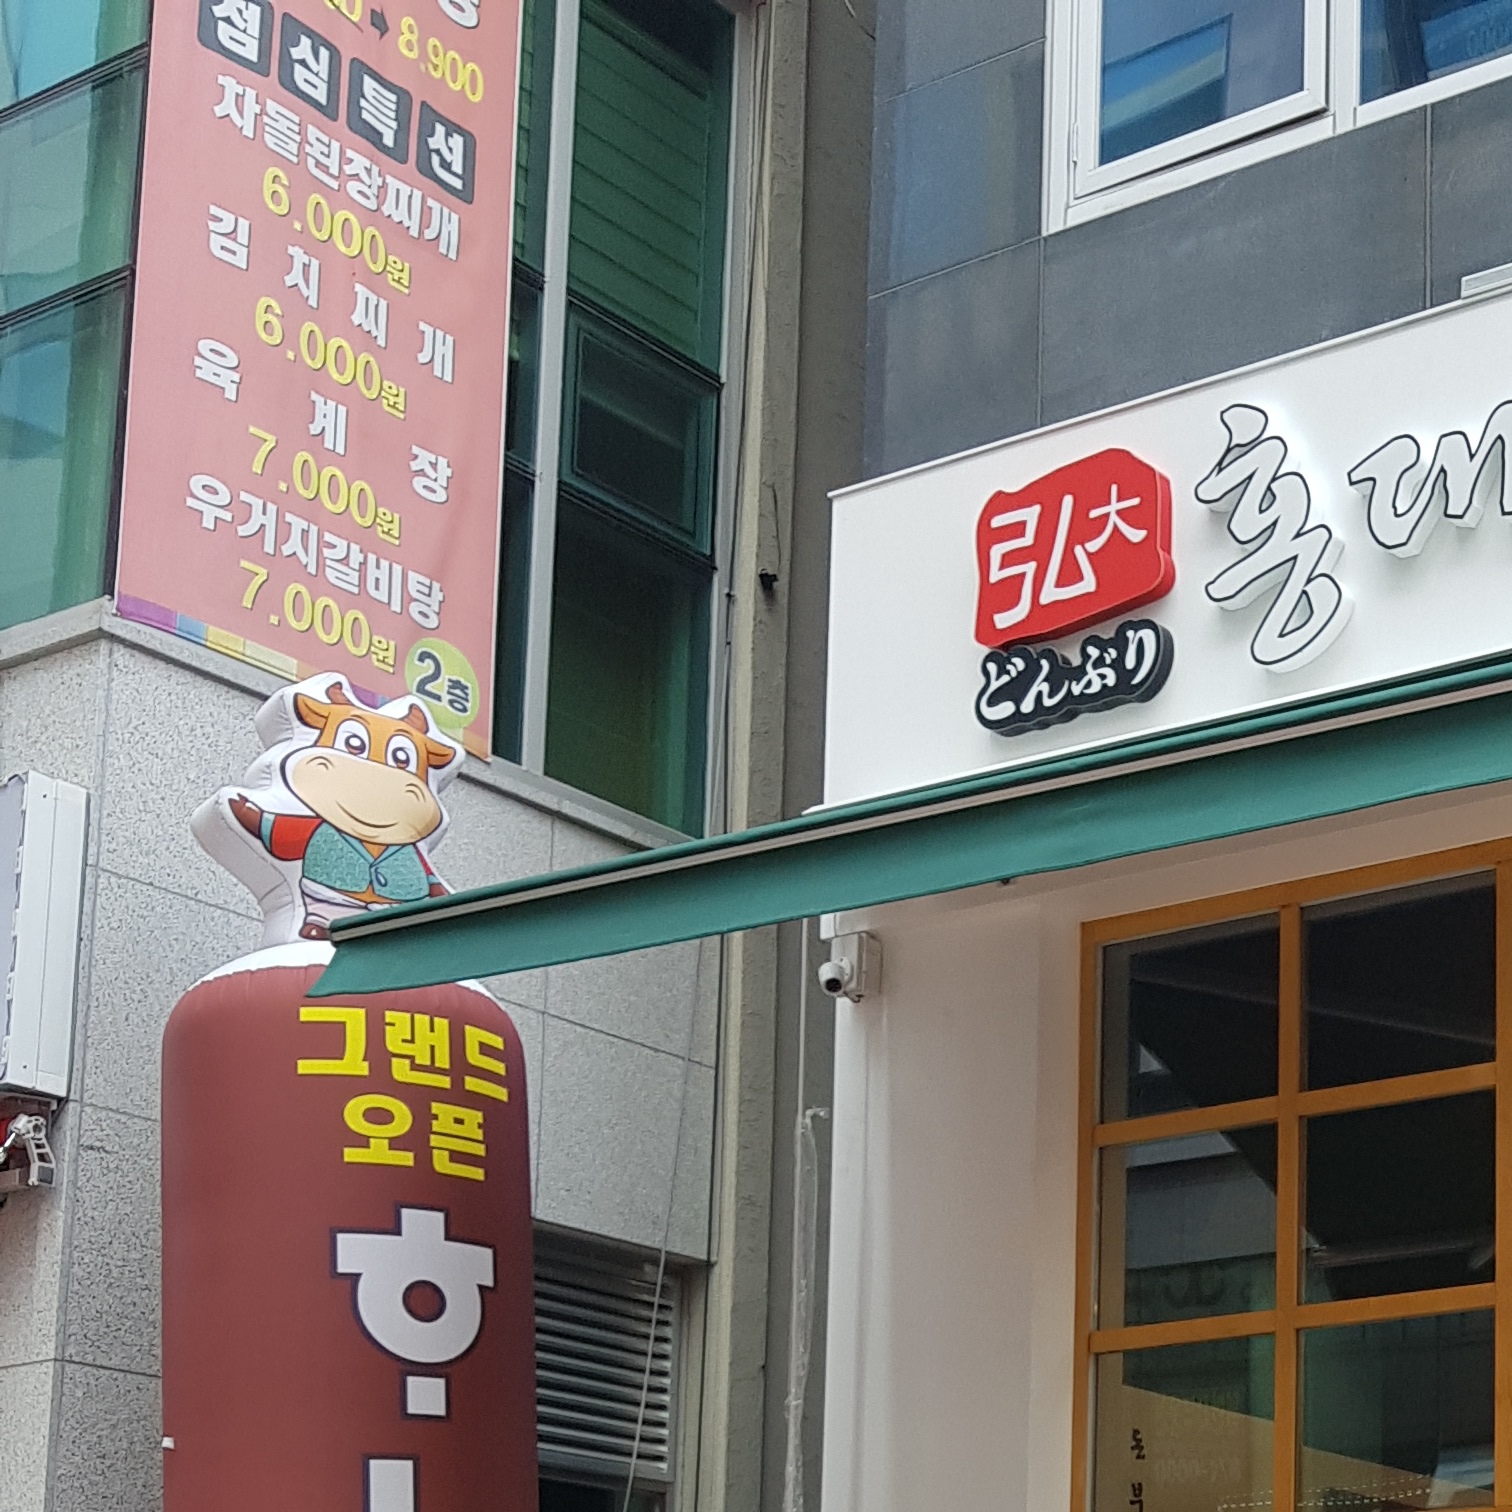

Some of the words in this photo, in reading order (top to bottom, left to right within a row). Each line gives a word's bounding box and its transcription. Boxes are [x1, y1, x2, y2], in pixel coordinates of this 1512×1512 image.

[213, 74, 460, 261] 차돌된장찌개
[186, 474, 445, 630] 우거지갈비탕
[414, 649, 470, 715] 2층
[978, 620, 1160, 722] どんぶり
[297, 1006, 509, 1102] 그랜드
[343, 1093, 487, 1181] 오픈
